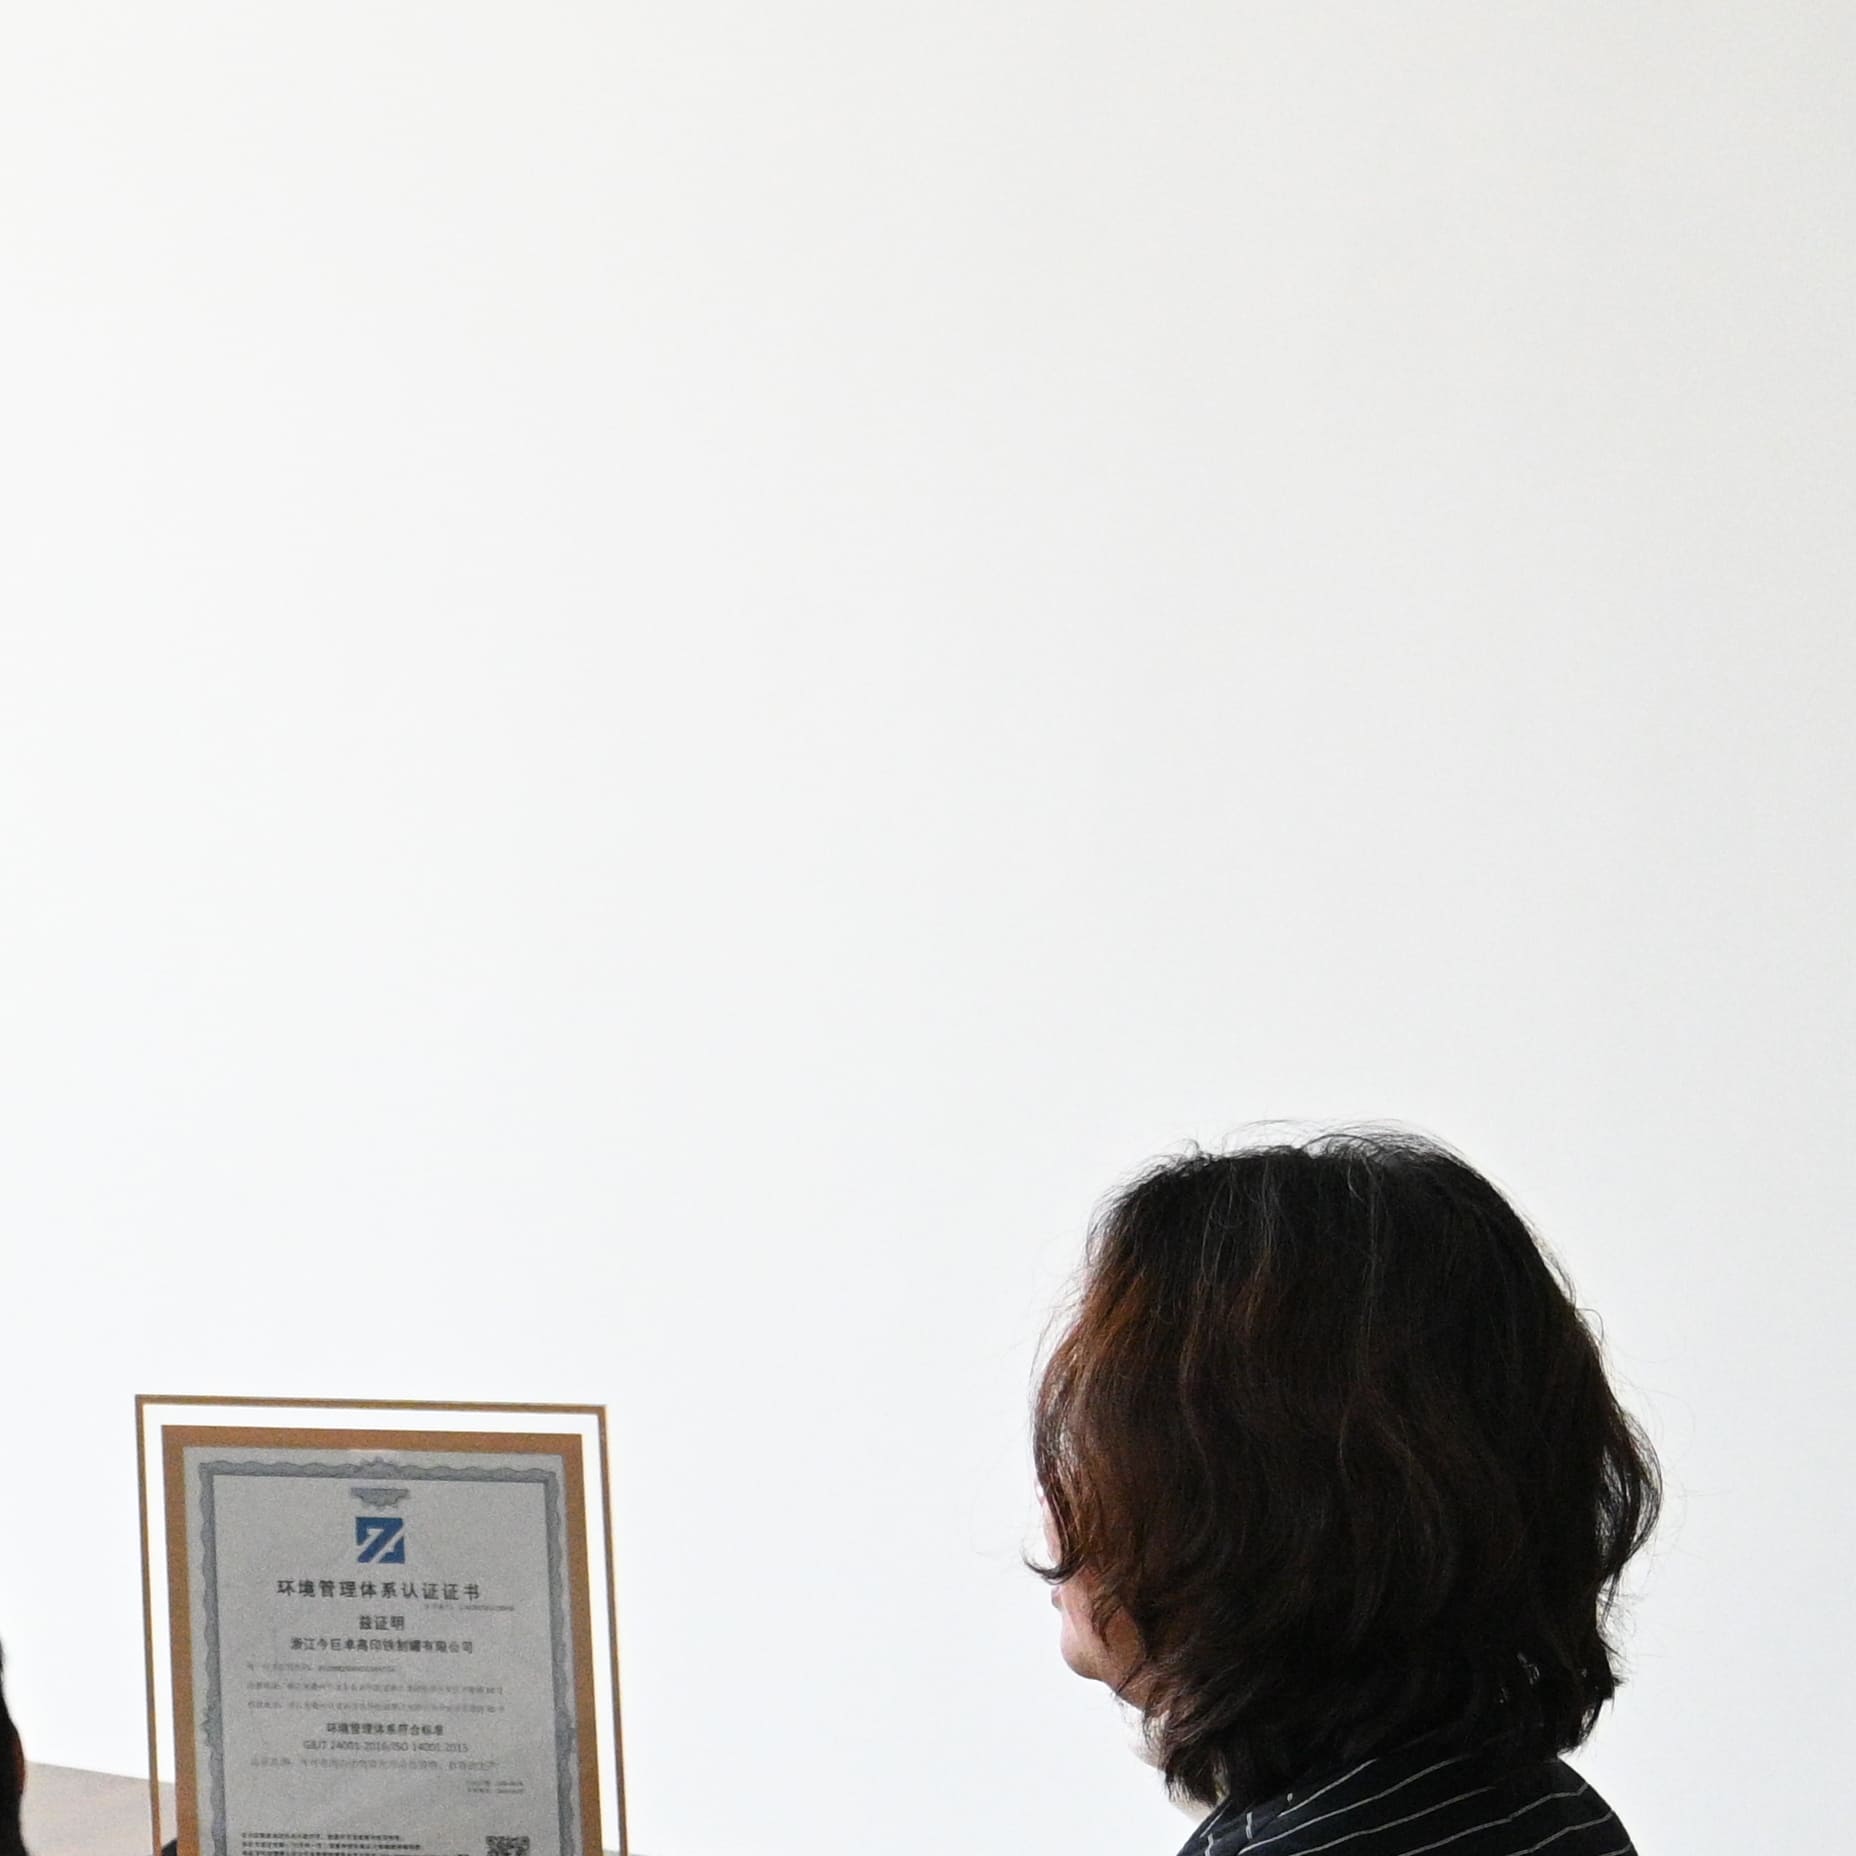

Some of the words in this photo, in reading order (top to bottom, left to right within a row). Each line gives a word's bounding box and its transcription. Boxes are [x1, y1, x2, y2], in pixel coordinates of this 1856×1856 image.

[277, 1579, 481, 1601] 环境管理体系认证证书
